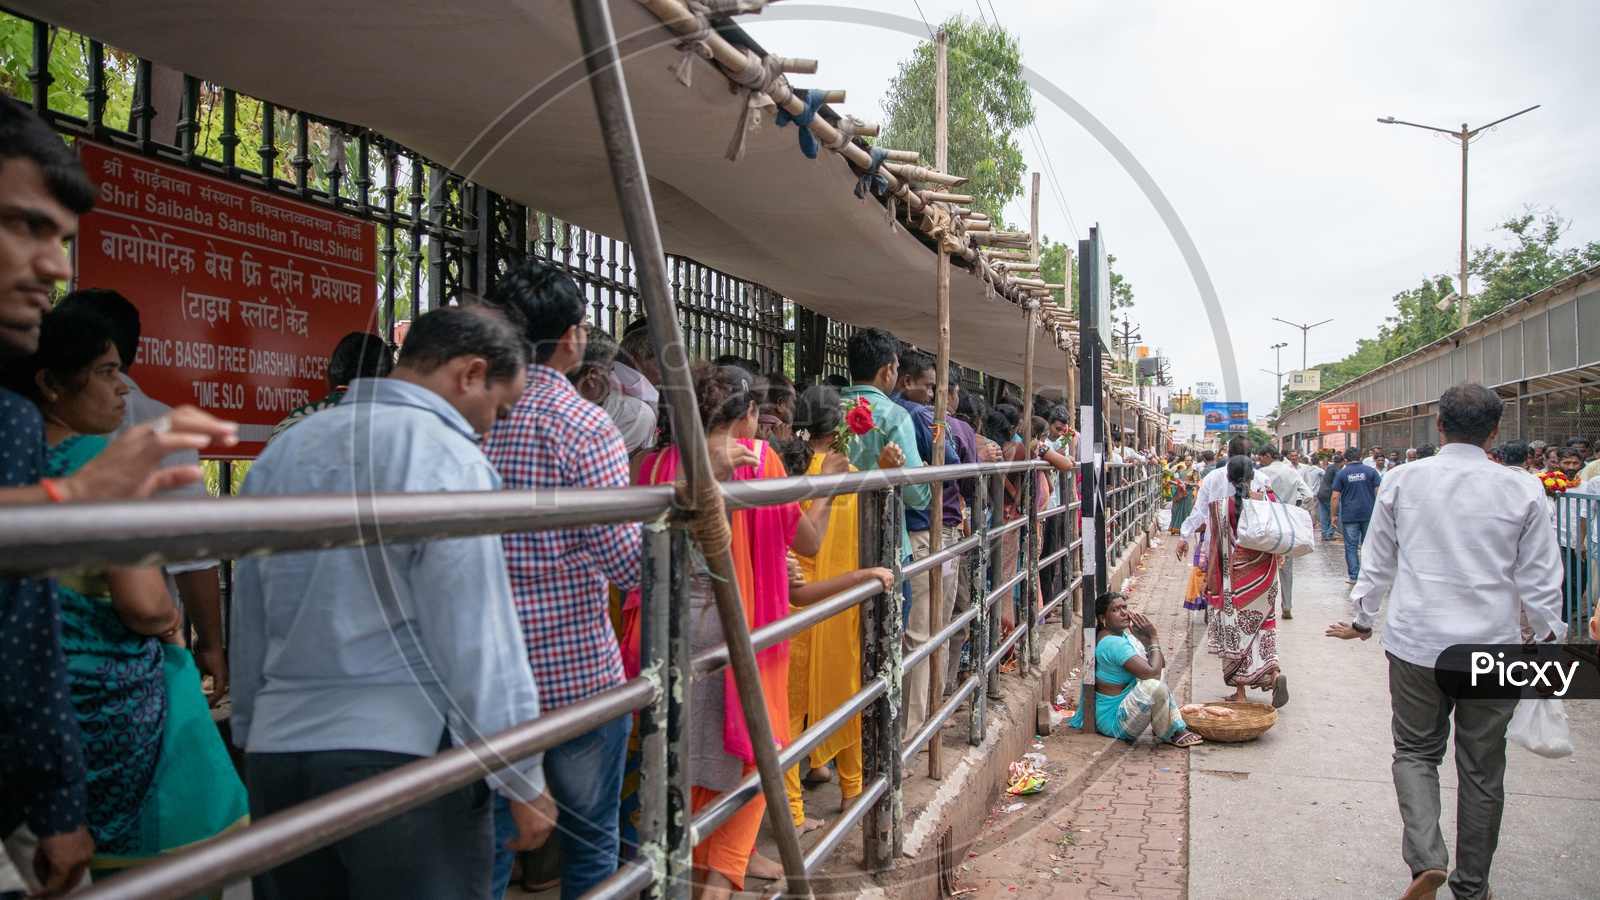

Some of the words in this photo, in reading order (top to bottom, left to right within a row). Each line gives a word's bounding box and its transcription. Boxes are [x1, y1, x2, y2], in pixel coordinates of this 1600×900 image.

[102, 157, 124, 178] श्री
[131, 168, 192, 196] साईबाबा
[198, 184, 243, 210] संस्थान
[100, 182, 139, 209] Shri
[145, 193, 213, 227] Saibaba
[218, 212, 287, 244] Sansthan
[100, 223, 196, 275] बायोमेट्रिक
[204, 240, 234, 281] बेस
[240, 250, 262, 287] फ्रि
[268, 259, 304, 294] दर्शन
[310, 266, 362, 305] प्रवेशपत्र
[181, 286, 232, 328] (टाइम
[175, 340, 215, 370] BASED
[218, 345, 246, 373] FREE
[248, 348, 296, 378] DARSHAN
[1304, 375, 1316, 383] LIC
[192, 380, 220, 409] TIME
[256, 385, 310, 412] COUNTERS
